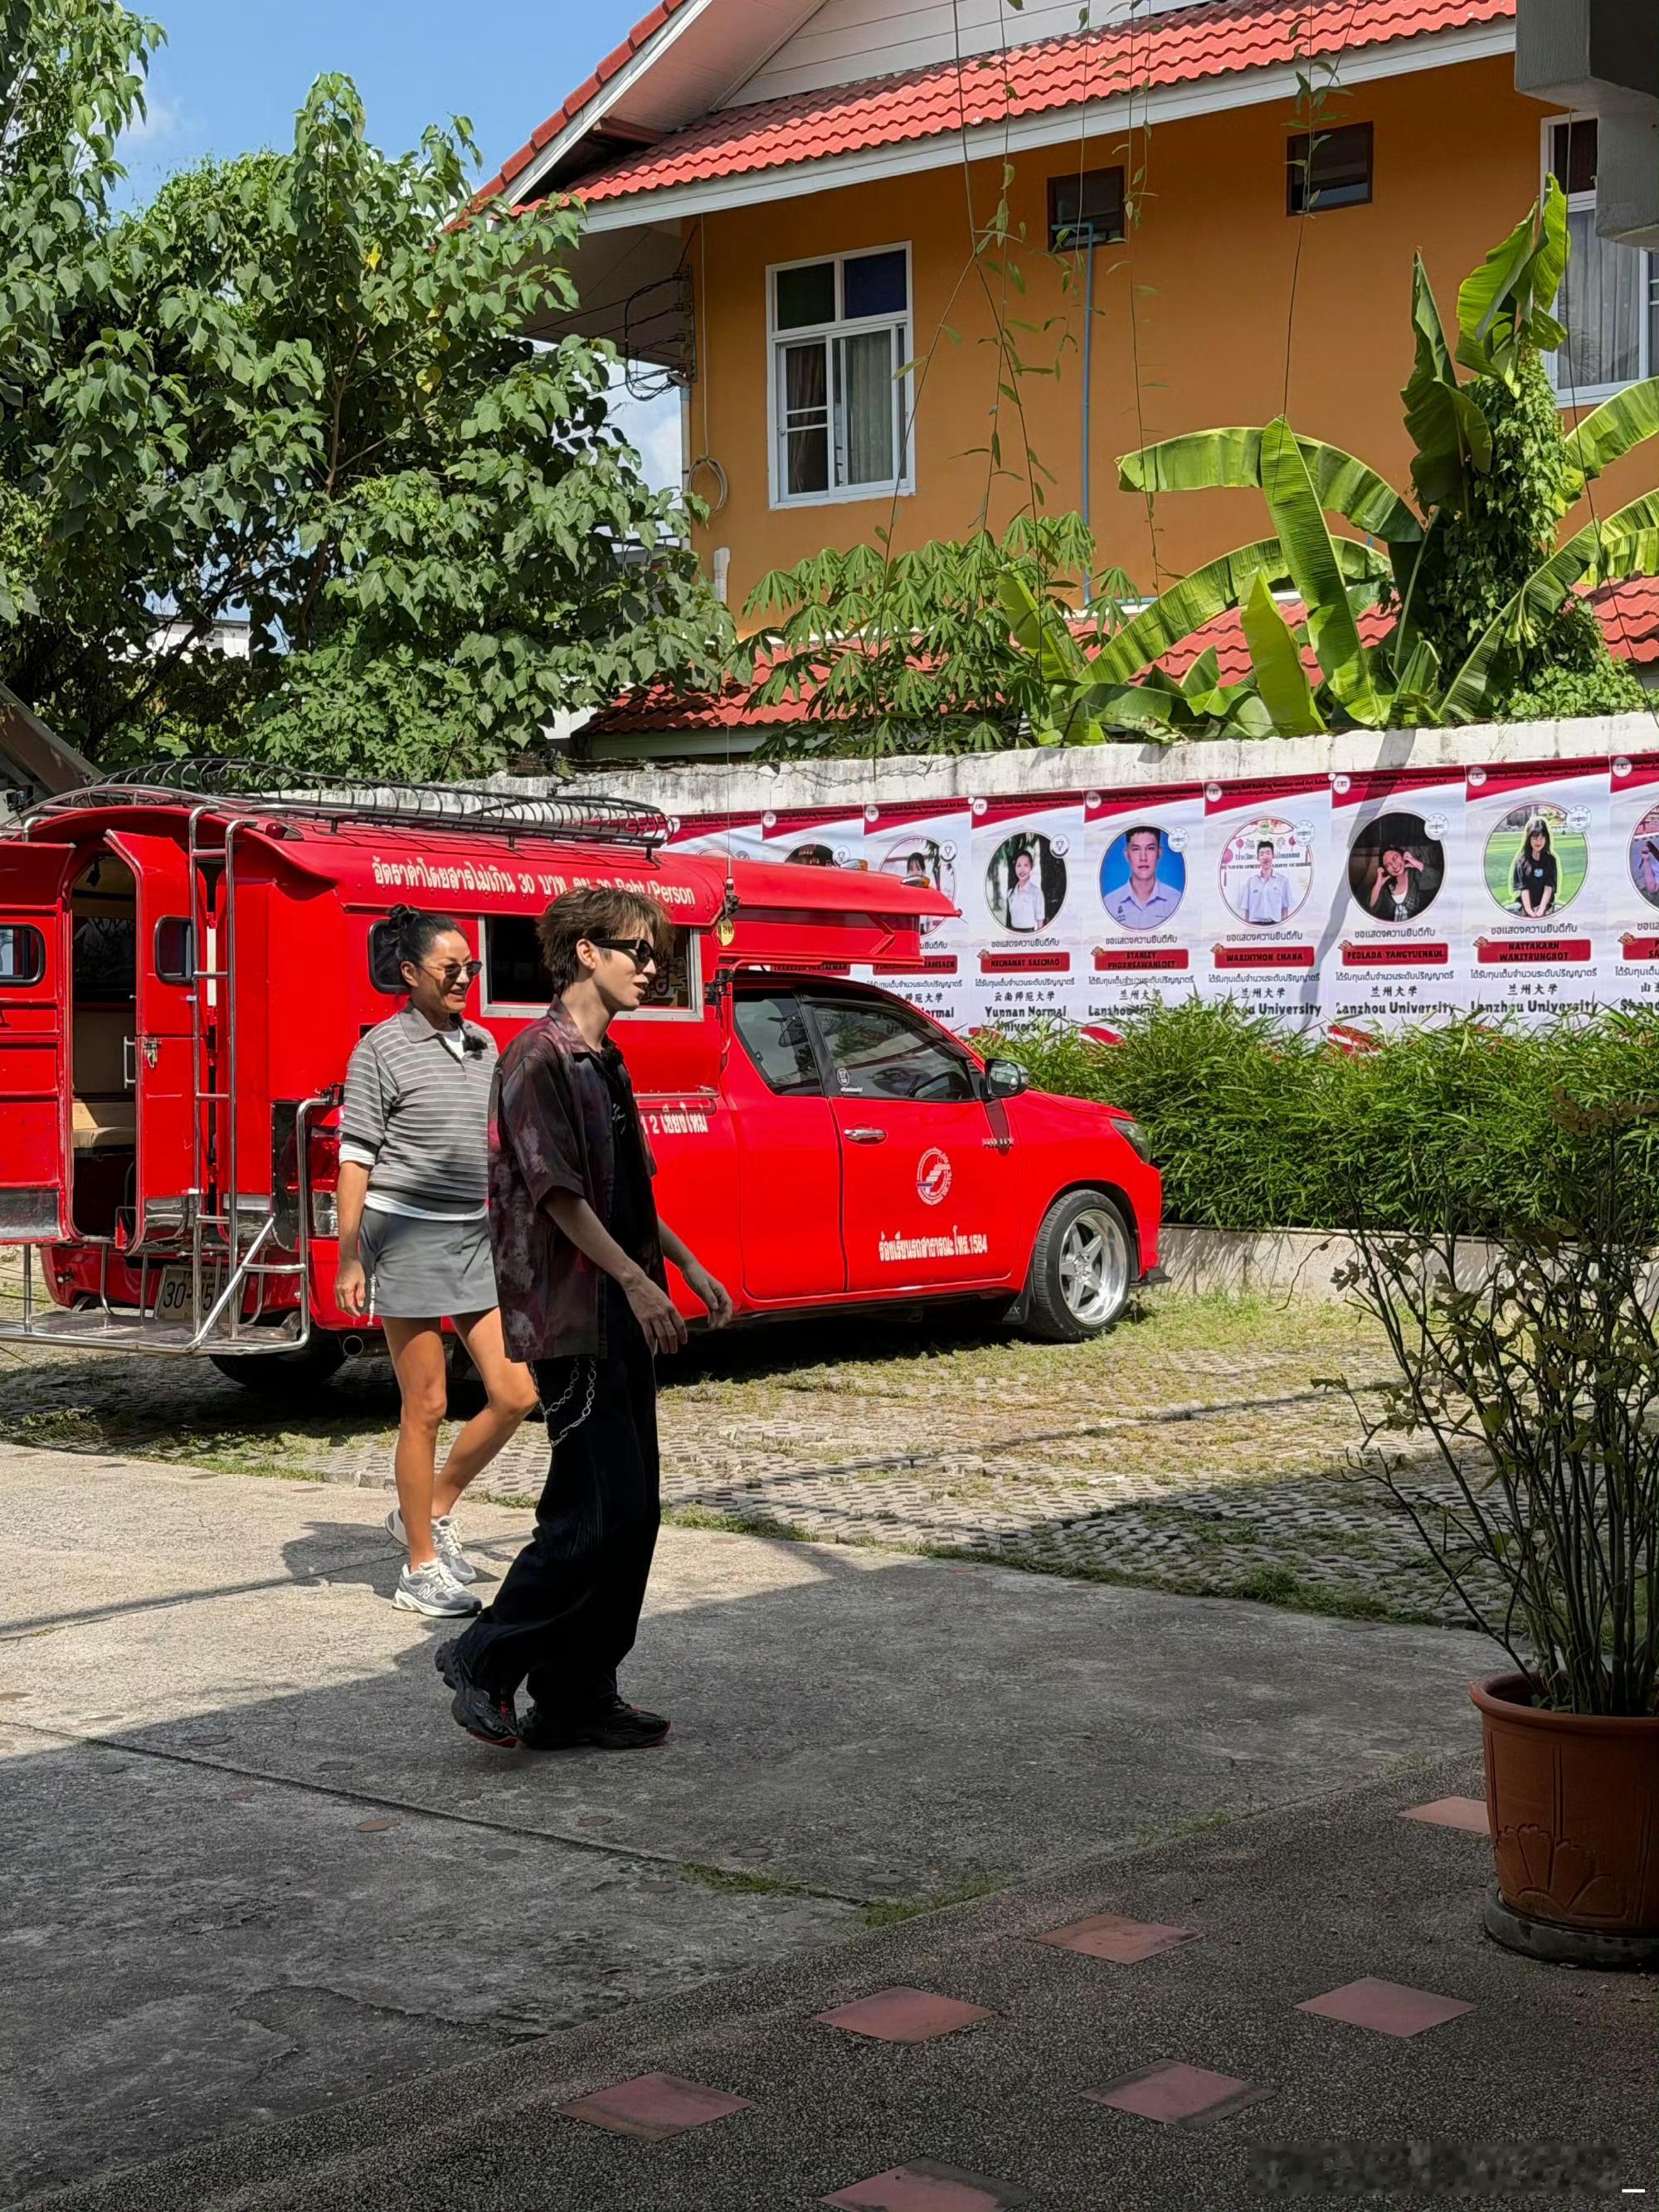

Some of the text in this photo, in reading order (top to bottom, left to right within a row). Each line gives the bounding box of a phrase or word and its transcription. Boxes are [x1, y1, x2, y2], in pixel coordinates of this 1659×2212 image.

[372, 855, 516, 893] อัตราค่าโดยสารไม่เกิน
[518, 873, 536, 894] 30
[538, 875, 567, 896] บาท
[1355, 927, 1436, 938] ขอแสดงความยินดีกับ
[1491, 923, 1578, 935] ขอแสดงความยินดีกับ
[1226, 931, 1303, 942] ขอแสดงความยินดีกับ
[1370, 985, 1418, 997] 兰州大学
[1507, 983, 1558, 995] 兰州大学
[994, 991, 1055, 1002] 云南师范大学
[922, 1006, 955, 1018] ormal
[985, 1005, 1067, 1018] Yunnan Normal
[1258, 1002, 1322, 1018] University
[1335, 1001, 1456, 1017] Lanzhou University
